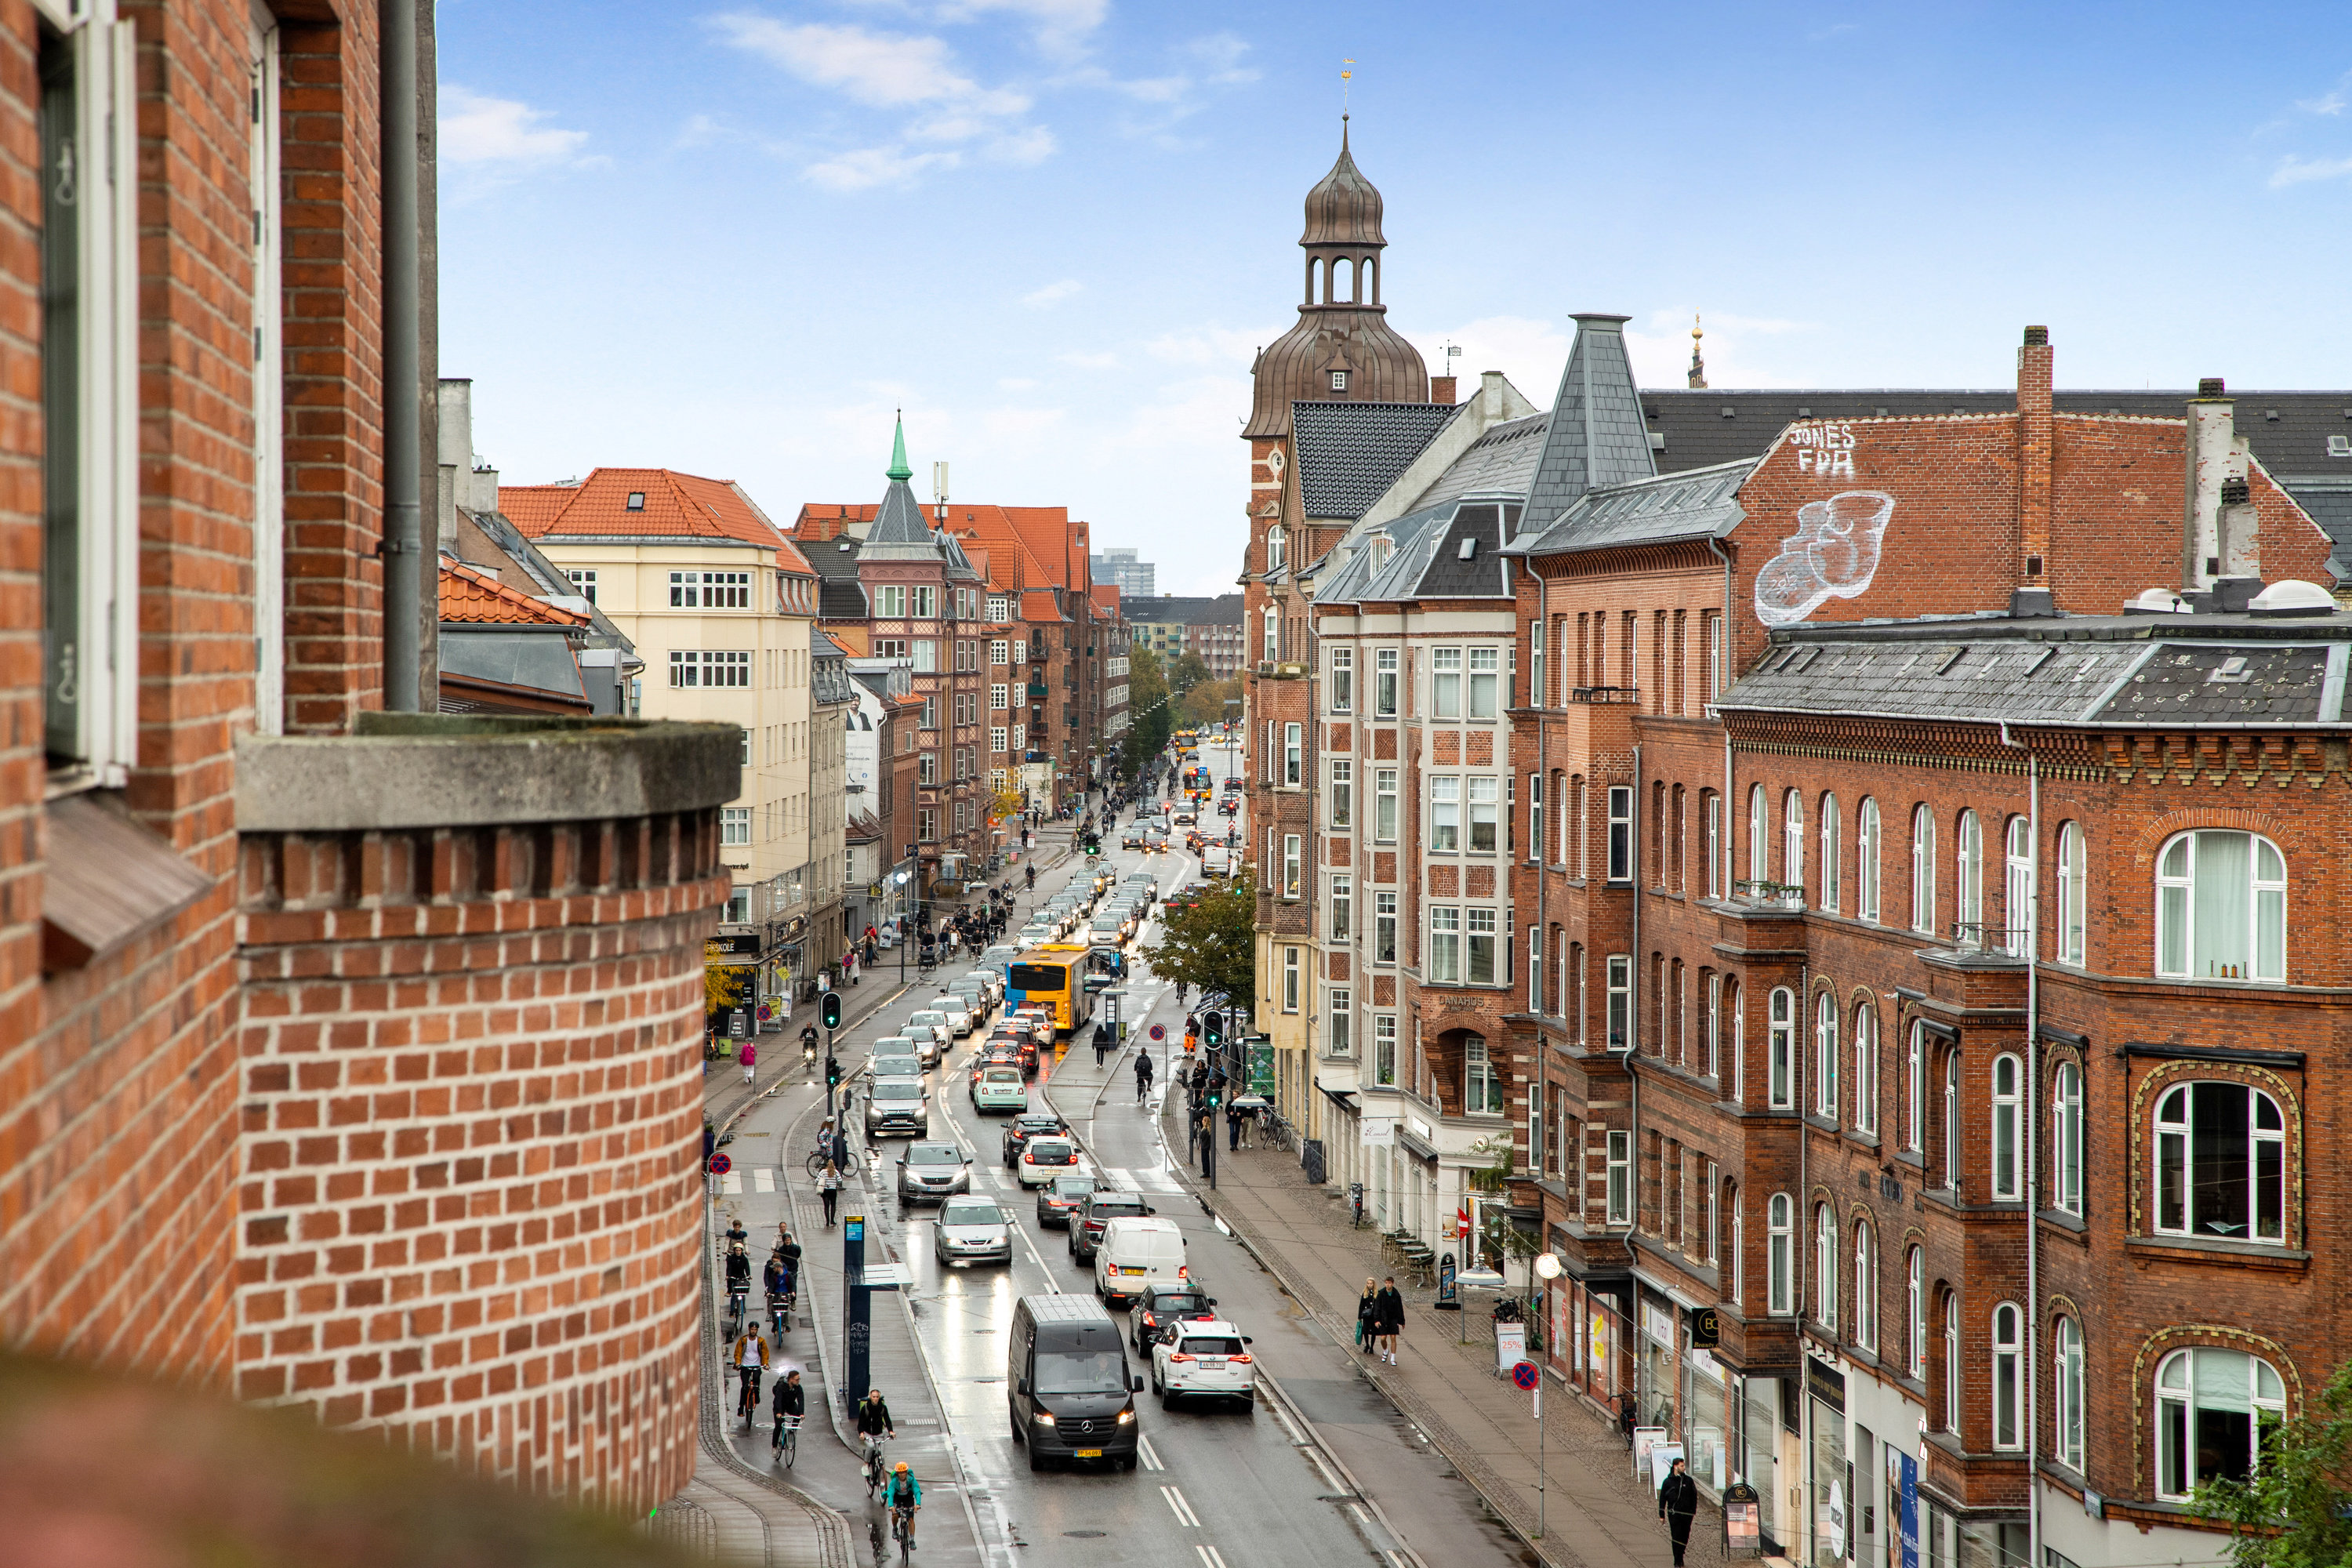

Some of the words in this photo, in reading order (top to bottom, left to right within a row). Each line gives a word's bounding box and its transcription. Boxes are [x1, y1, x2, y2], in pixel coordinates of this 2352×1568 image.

[1790, 424, 1856, 449] JONES
[1439, 995, 1484, 1007] DANAHUS
[1501, 1341, 1523, 1349] 25%
